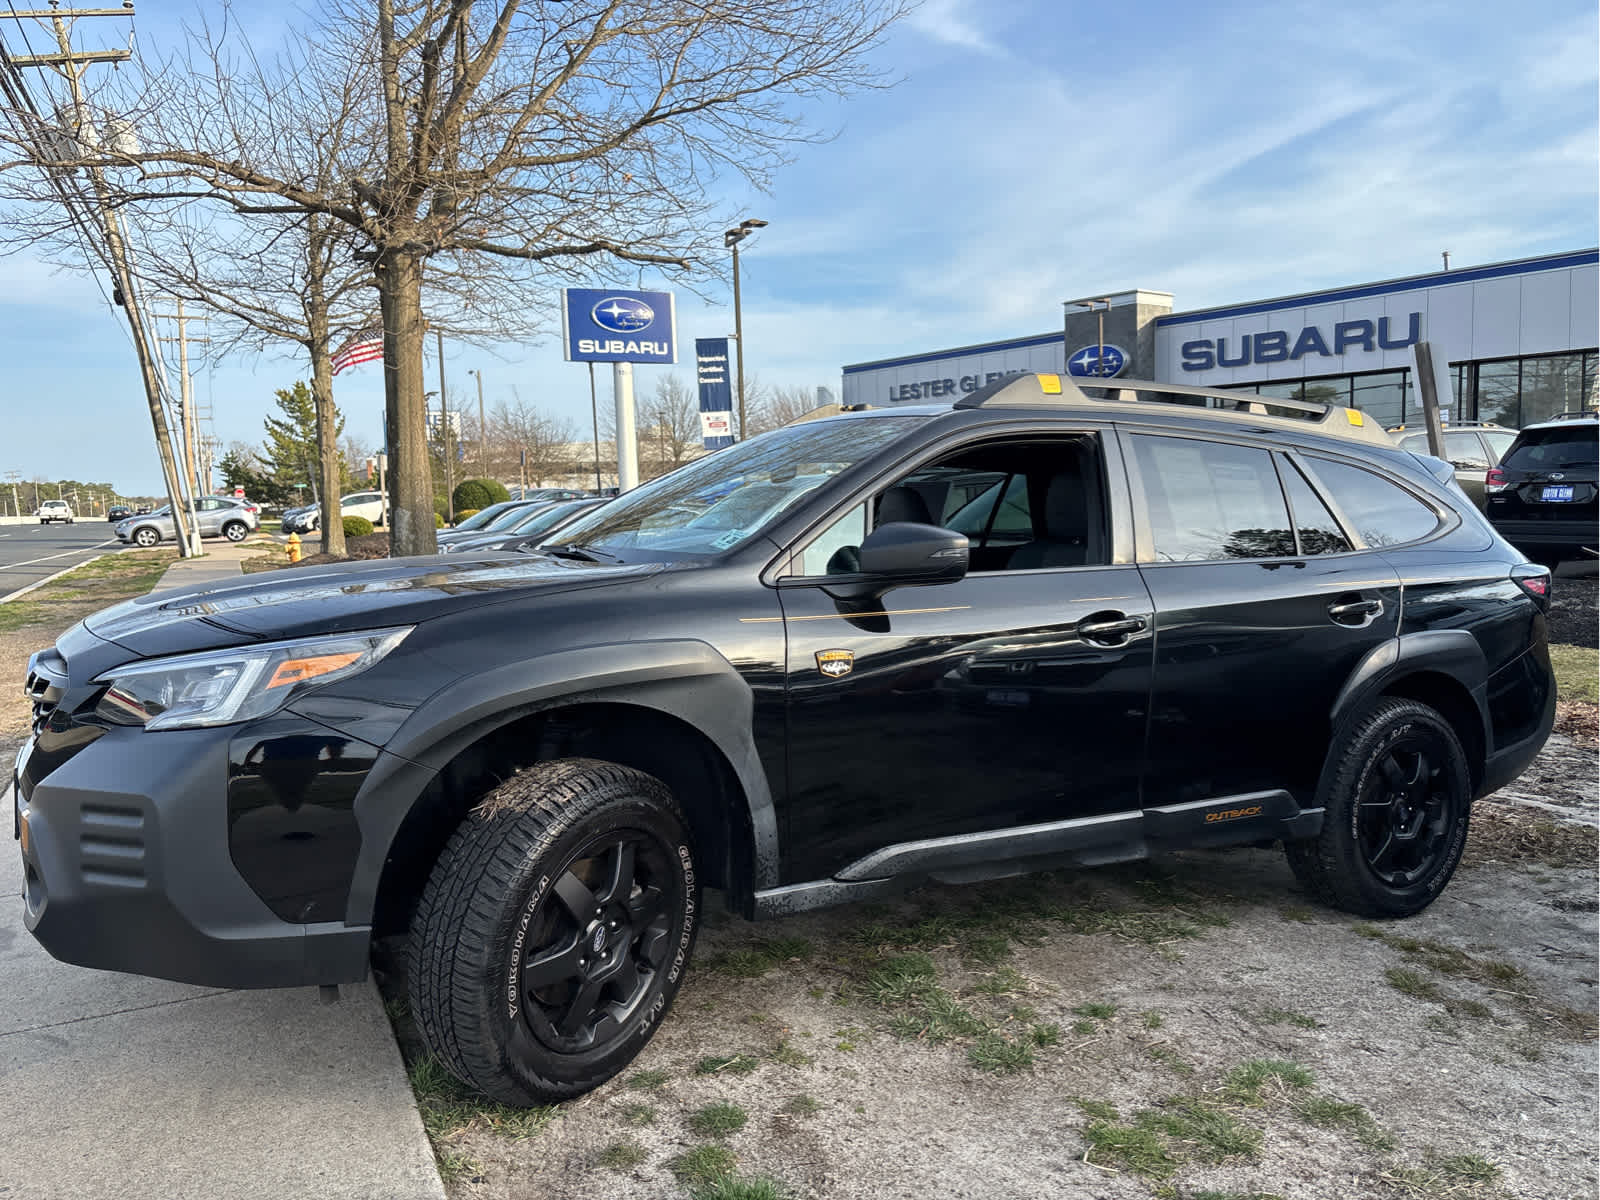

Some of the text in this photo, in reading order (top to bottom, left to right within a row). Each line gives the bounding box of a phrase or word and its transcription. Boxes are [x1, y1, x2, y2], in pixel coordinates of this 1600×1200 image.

[578, 339, 668, 356] SUBARU
[1180, 312, 1420, 372] SUBARU
[889, 368, 1028, 402] LESTER GLE
[1205, 806, 1262, 822] OUTBACK
[667, 845, 695, 984] GEOLANDAR
[507, 875, 550, 1020] YOKOHAMA
